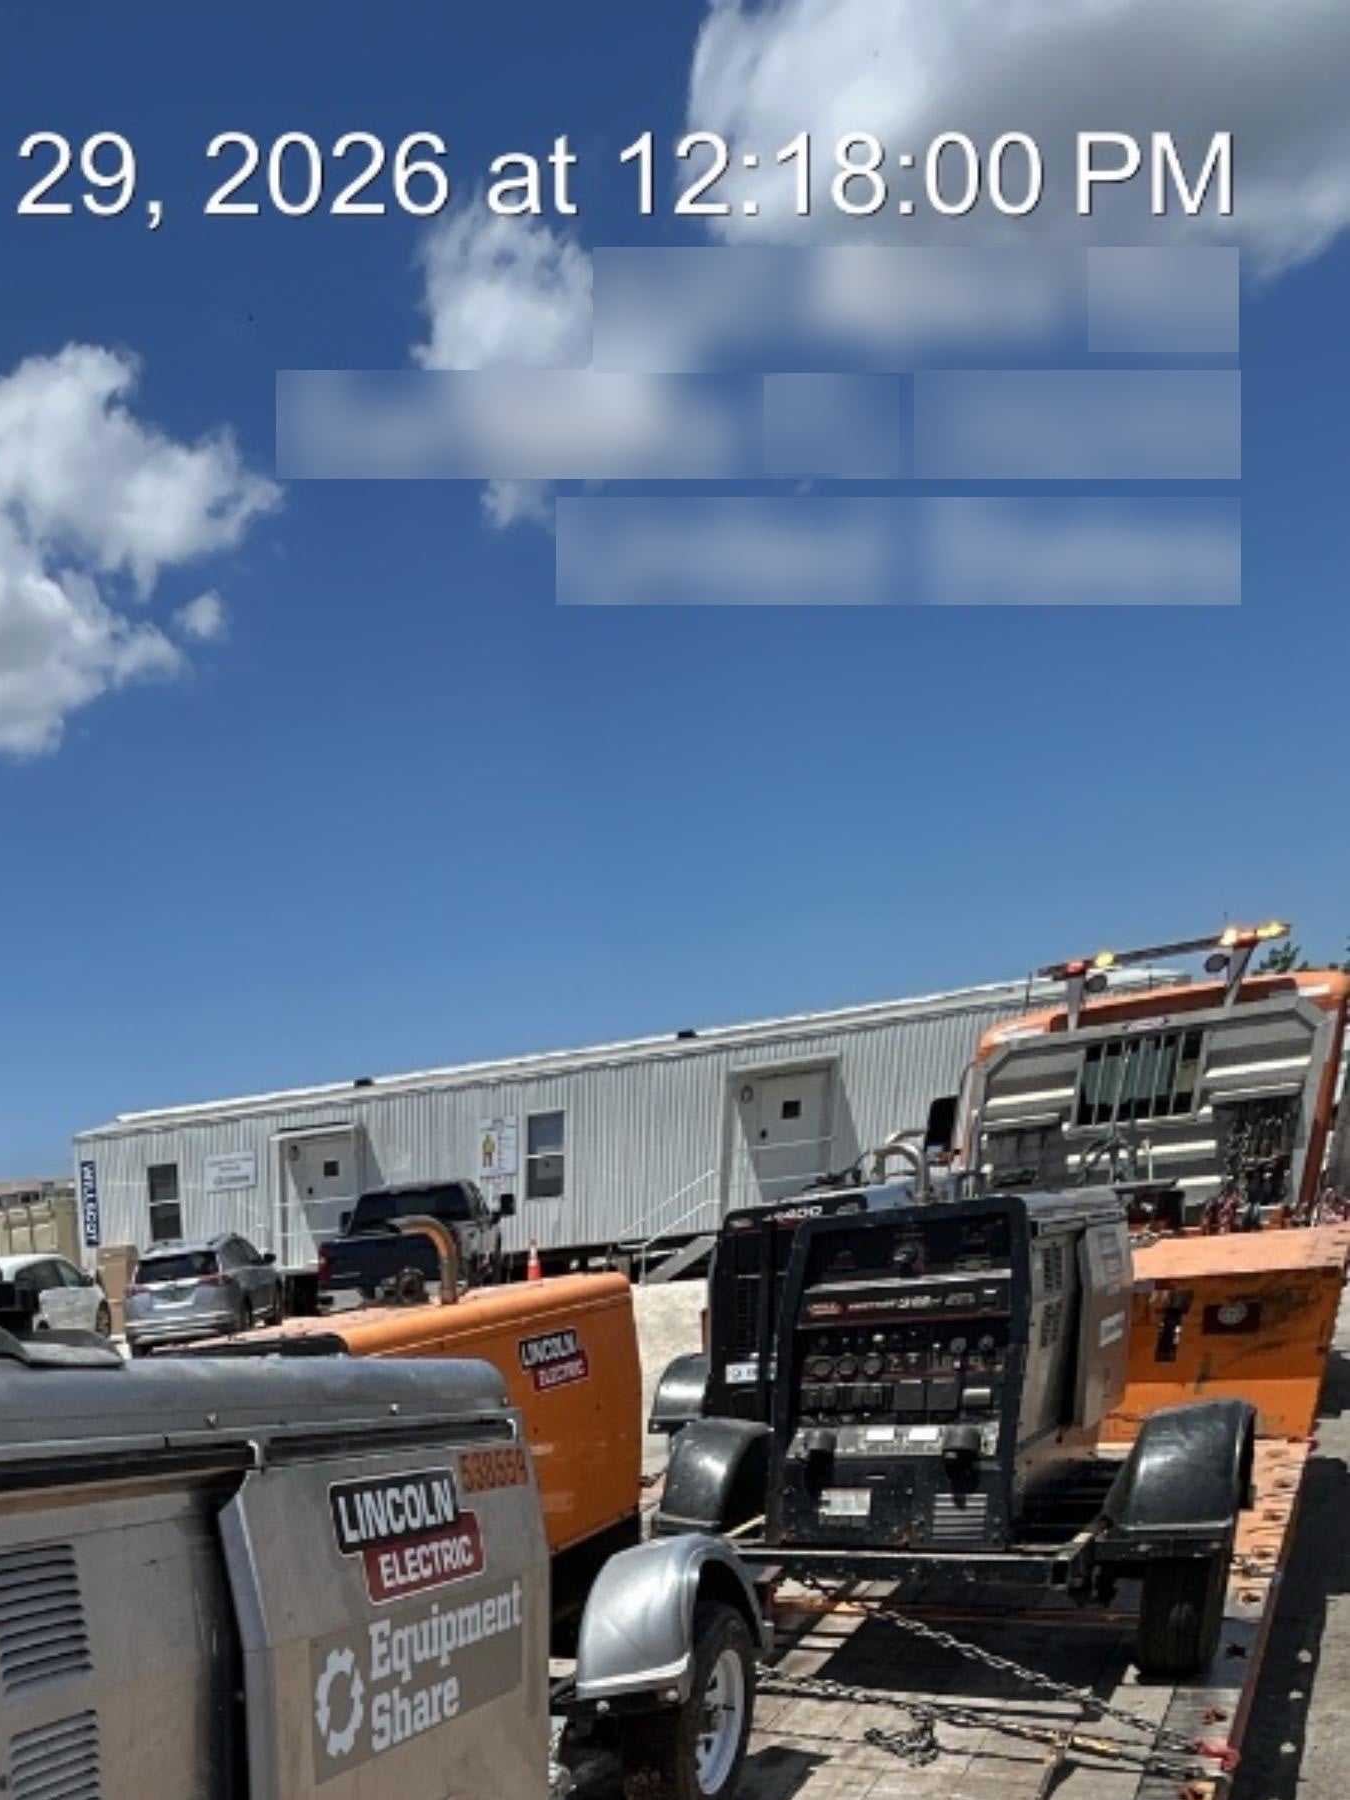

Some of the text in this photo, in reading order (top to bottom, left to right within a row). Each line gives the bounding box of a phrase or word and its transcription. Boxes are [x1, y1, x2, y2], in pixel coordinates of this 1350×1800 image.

[521, 1331, 581, 1368] LINCOLN
[538, 1357, 587, 1388] ELECTRIC
[336, 1476, 456, 1544] LINCOLN
[378, 1533, 475, 1588] ELECTRIC
[368, 1580, 524, 1683] Equipment
[370, 1674, 461, 1753] Share
